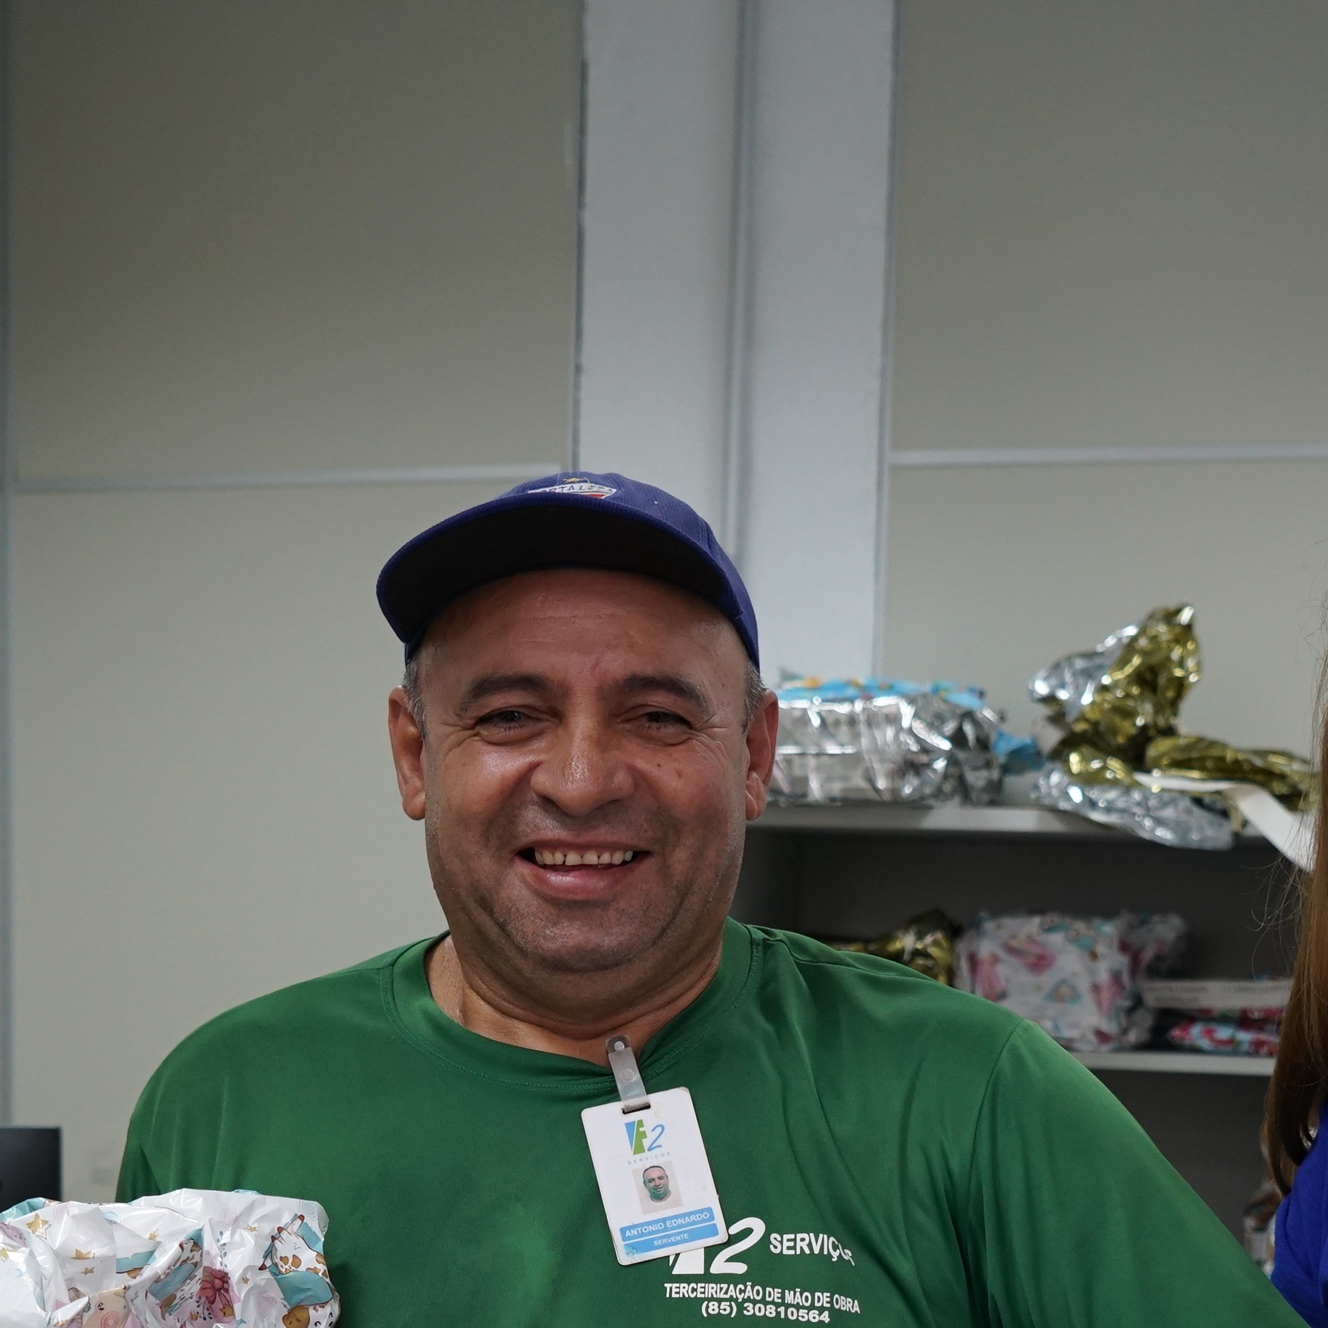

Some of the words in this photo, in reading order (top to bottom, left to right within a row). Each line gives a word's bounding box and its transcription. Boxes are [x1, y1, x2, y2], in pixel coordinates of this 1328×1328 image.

[627, 1151, 671, 1165] SERVIÇOS
[625, 1222, 665, 1238] ANTONIO
[666, 1211, 710, 1228] EDNARDO
[653, 1233, 690, 1247] SERVENTE
[664, 1282, 763, 1302] TERCEIRIZAÇÃO
[766, 1287, 782, 1302] DE
[785, 1288, 811, 1307] MÃO
[814, 1292, 831, 1307] DE
[833, 1294, 861, 1314] OBRA
[701, 1301, 737, 1318] (85)
[743, 1304, 831, 1324] 30810564
